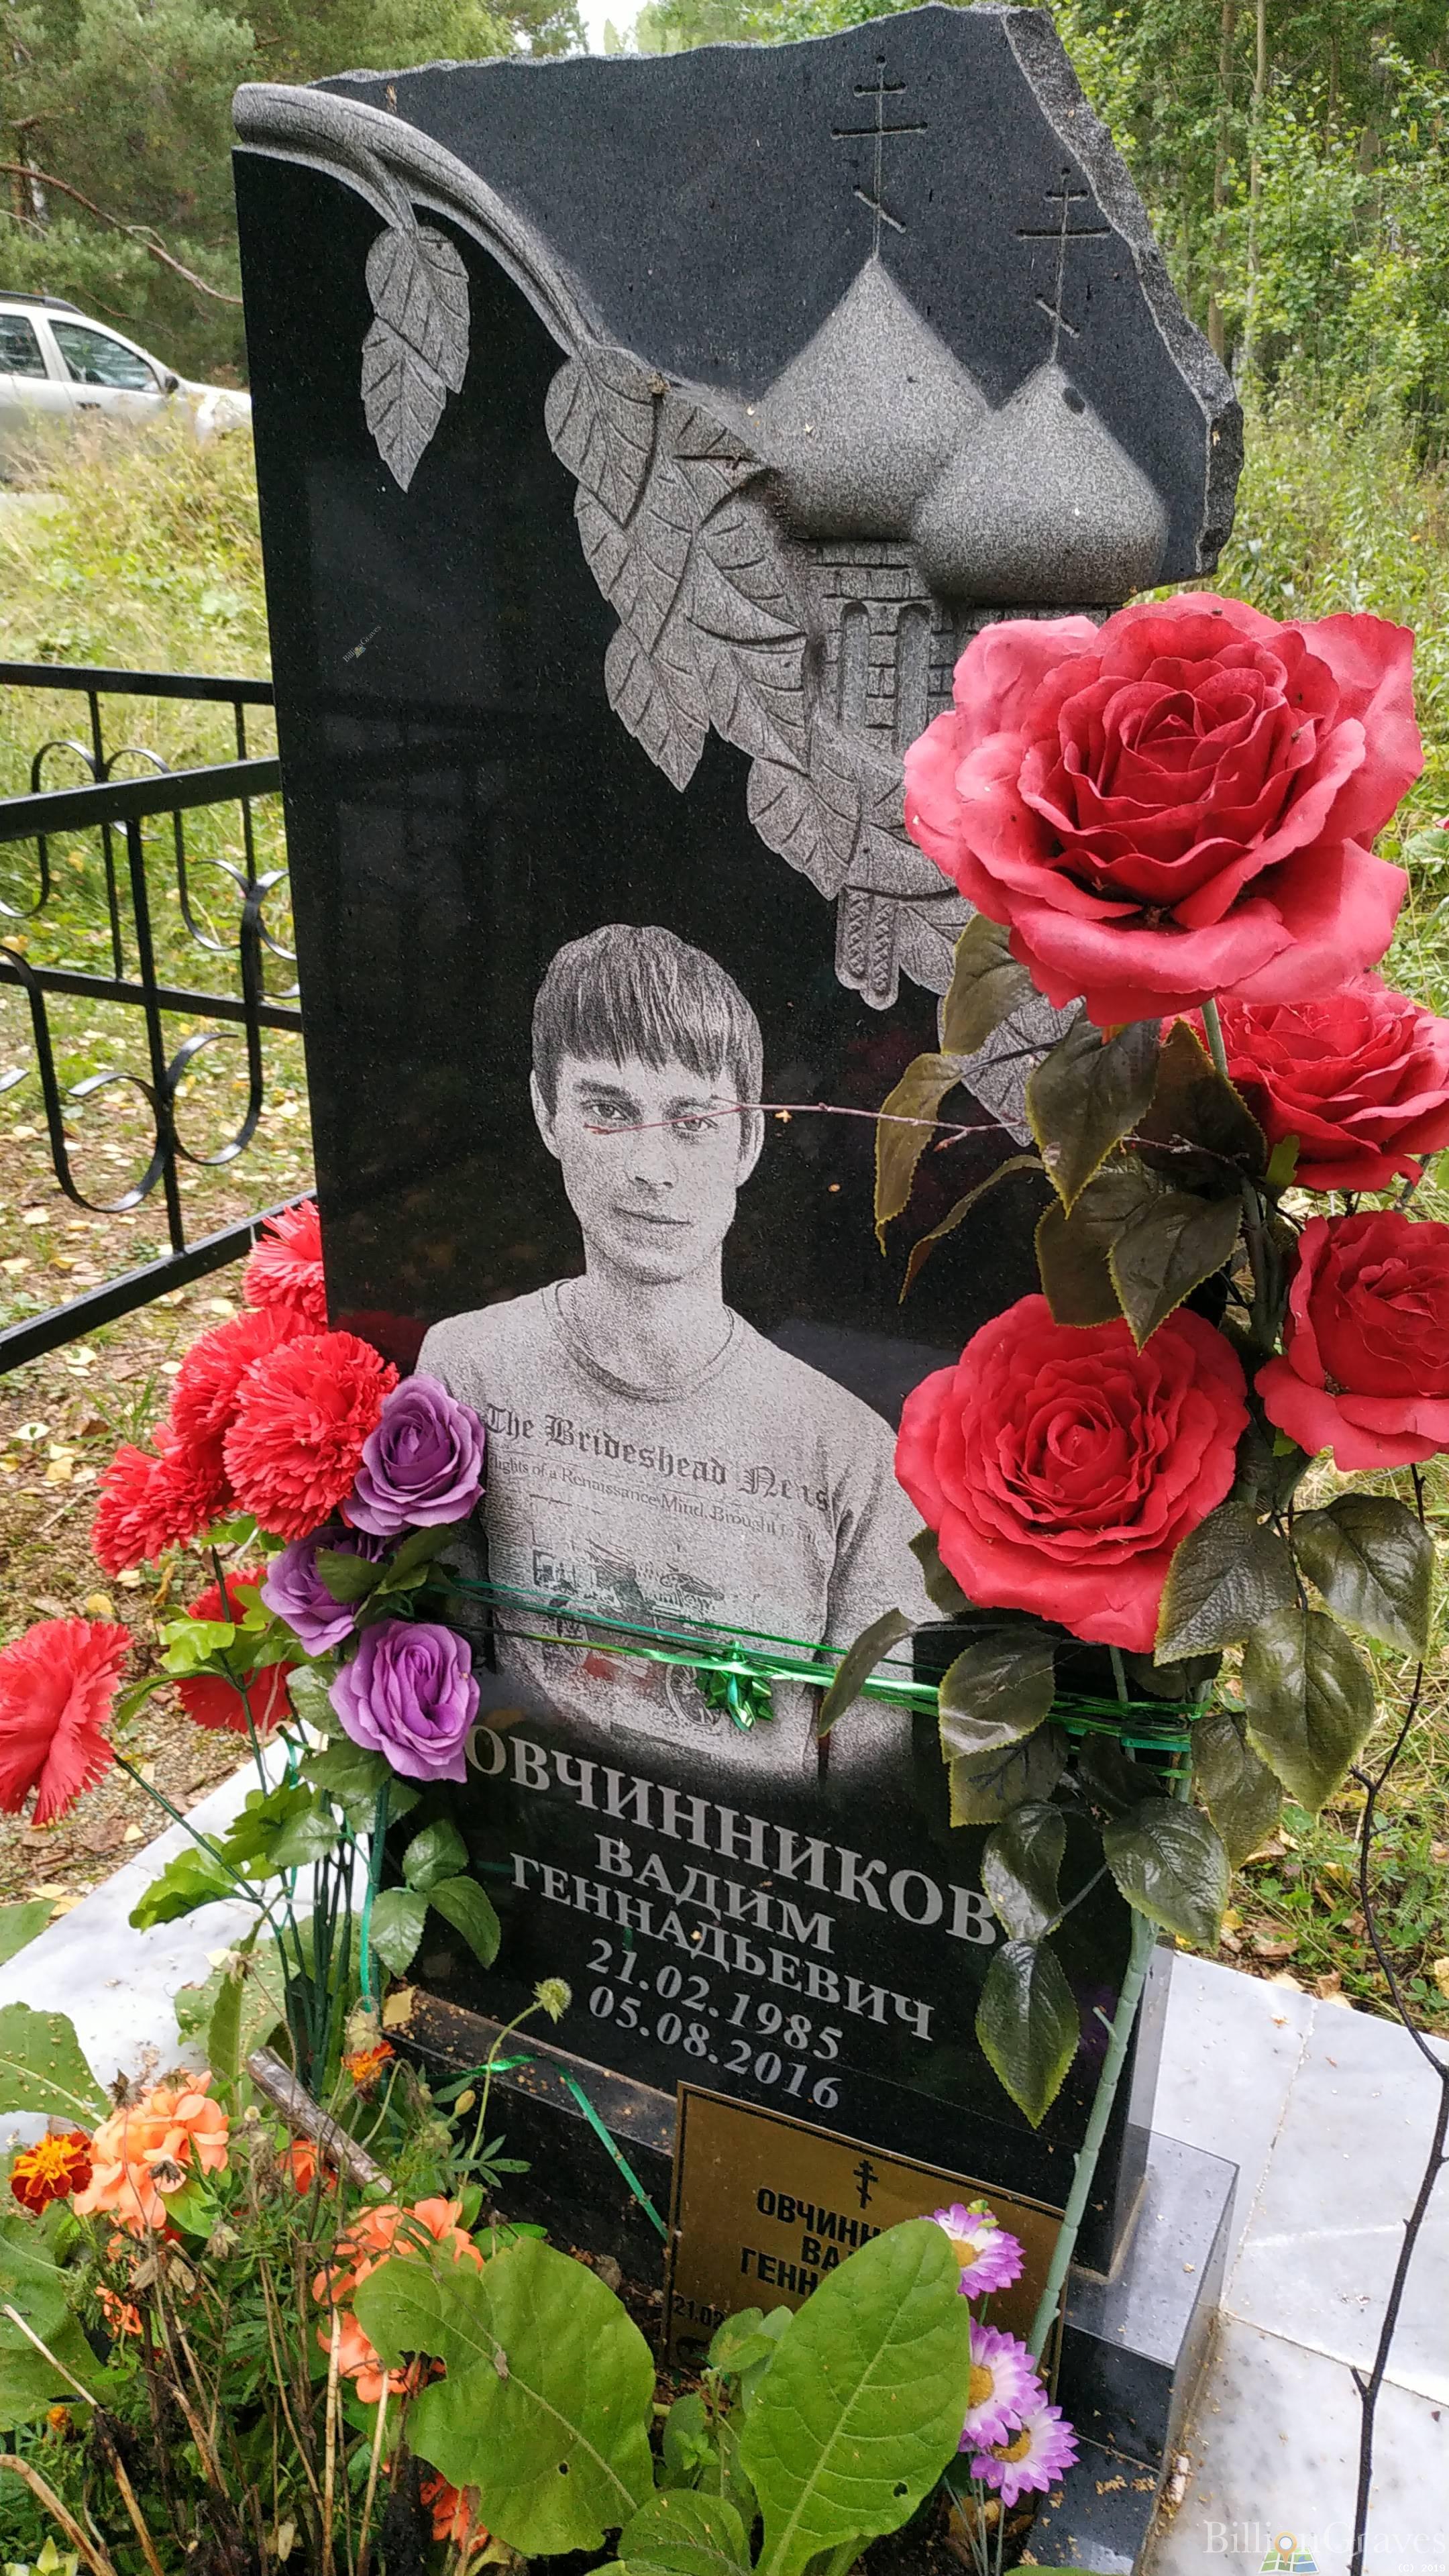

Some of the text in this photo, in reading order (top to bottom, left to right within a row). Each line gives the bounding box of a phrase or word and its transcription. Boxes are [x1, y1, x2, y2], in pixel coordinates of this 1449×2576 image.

[485, 1403, 535, 1441] The
[545, 1413, 727, 1486] Brideshead
[532, 1462, 549, 1477] of
[549, 1469, 557, 1480] a
[561, 1466, 657, 1506] Renaissance
[710, 1505, 776, 1536] Brought
[466, 1724, 997, 1945] ОВЧИННИКОВ
[594, 1833, 837, 1954] ВАДИМ
[509, 1851, 936, 2042] ГЕННАДЬЕВИЧ
[586, 1938, 843, 2060] 21.02.1985
[589, 1986, 843, 2109] 05.08.2016
[757, 2188, 881, 2248] ОВЧИНН
[801, 2235, 855, 2271] ВА
[673, 2295, 725, 2330] 21.02
[740, 2247, 819, 2298] ГЕНН
